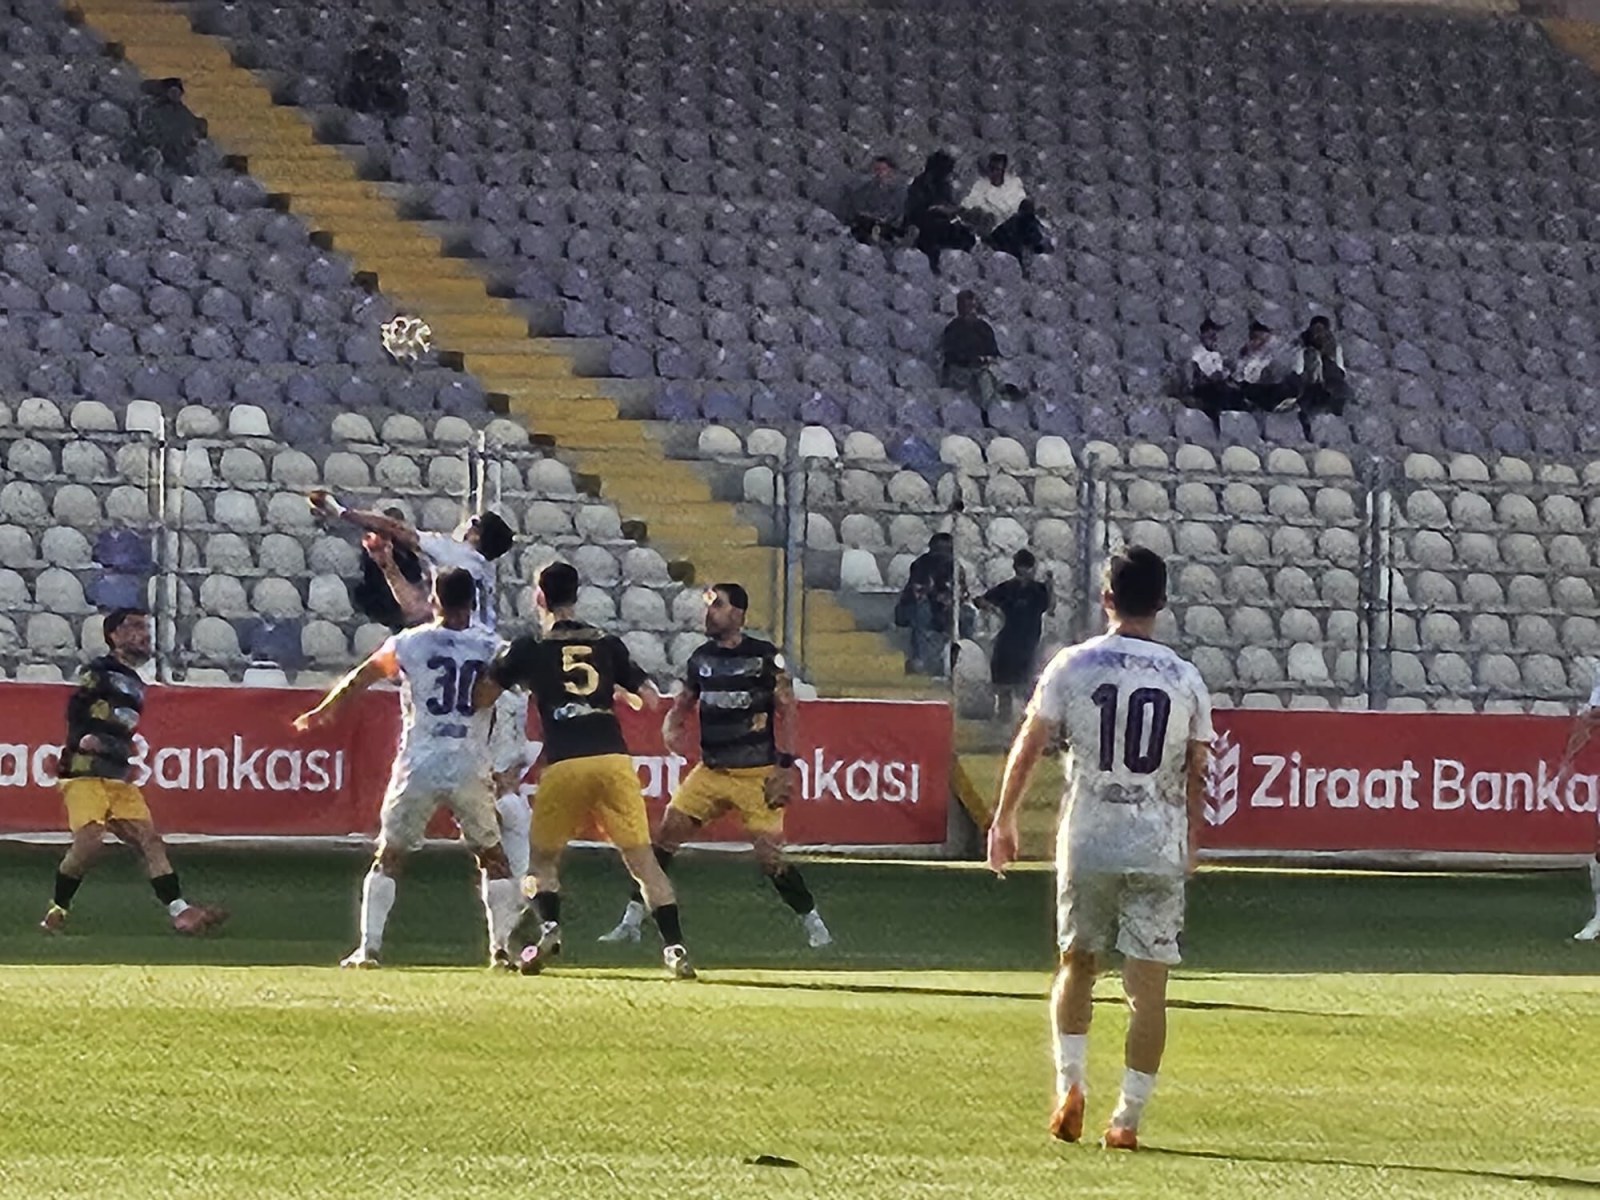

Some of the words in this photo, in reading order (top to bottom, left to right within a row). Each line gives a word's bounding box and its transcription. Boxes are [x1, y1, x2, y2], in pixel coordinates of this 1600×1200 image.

[426, 655, 487, 717] 30
[561, 645, 599, 696] 5
[1091, 683, 1171, 774] 10
[1250, 751, 1420, 810] Ziraat
[1432, 758, 1599, 813] Banka
